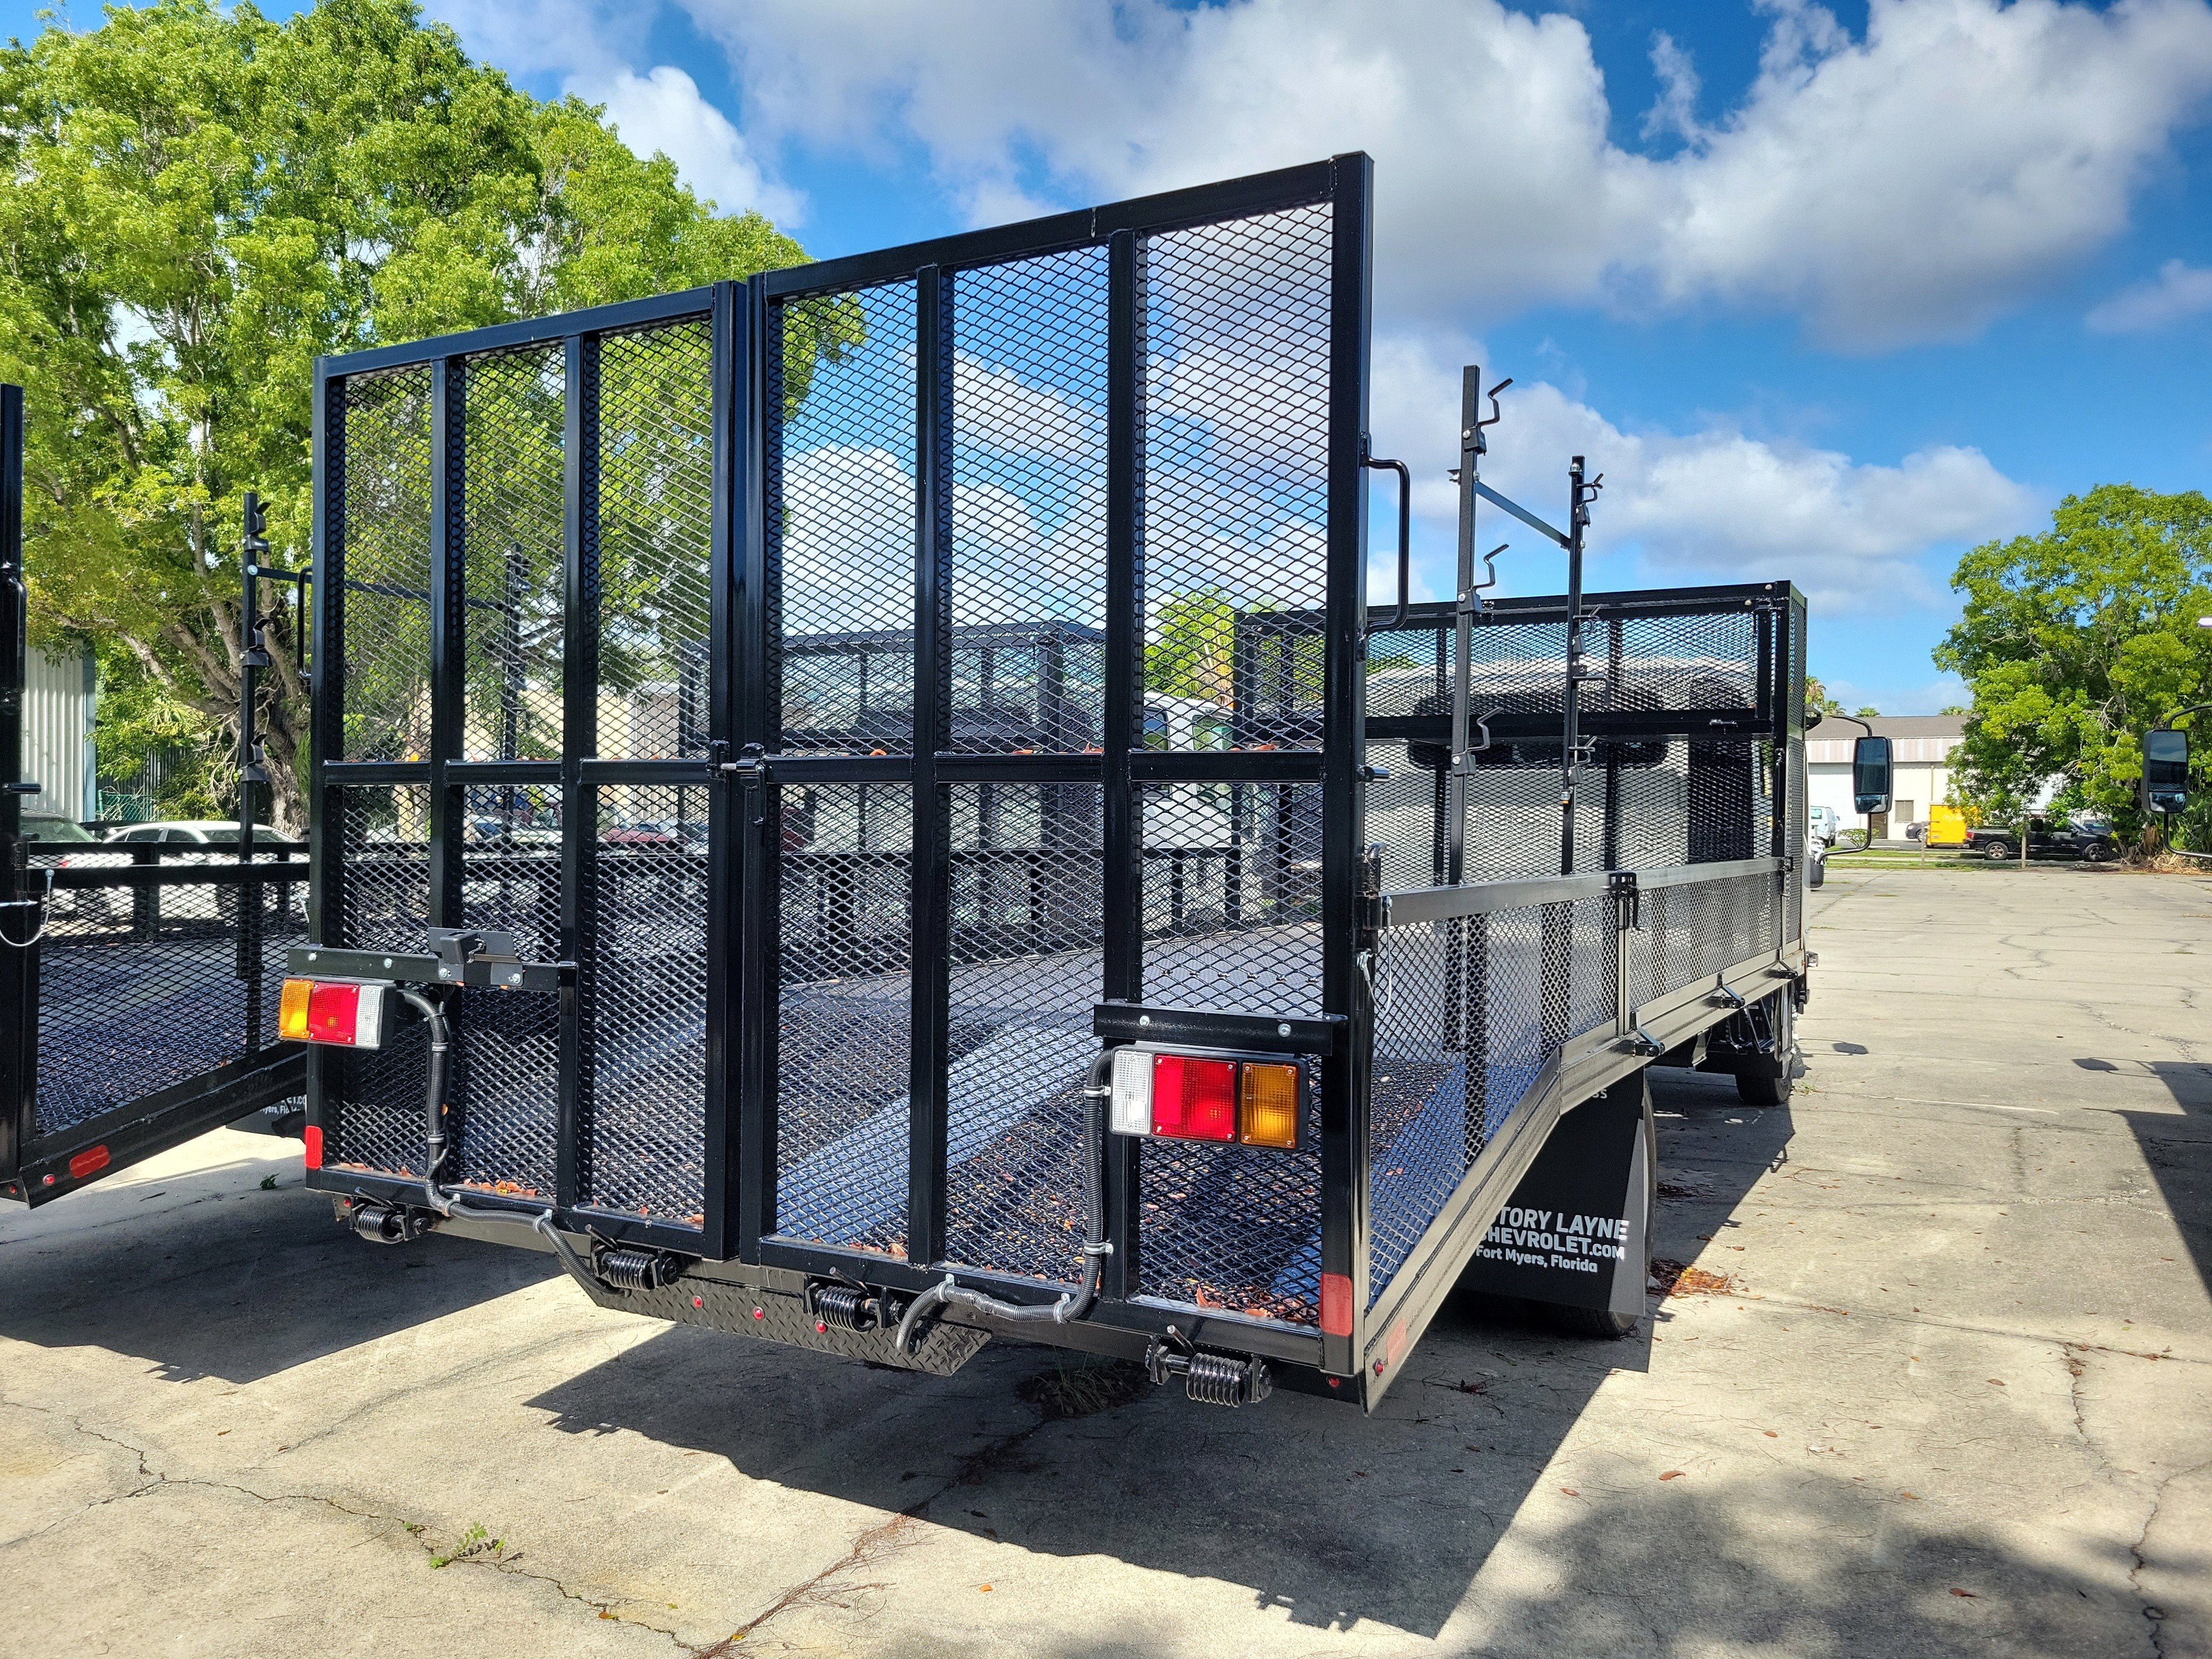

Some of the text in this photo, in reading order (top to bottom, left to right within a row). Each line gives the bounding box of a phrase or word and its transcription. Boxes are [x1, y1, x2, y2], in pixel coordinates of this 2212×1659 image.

[1556, 1212, 1629, 1241] LAYNE
[1481, 1226, 1625, 1261] HEVROLET.COM
[1476, 1245, 1598, 1273] Fort Myers, Florida
